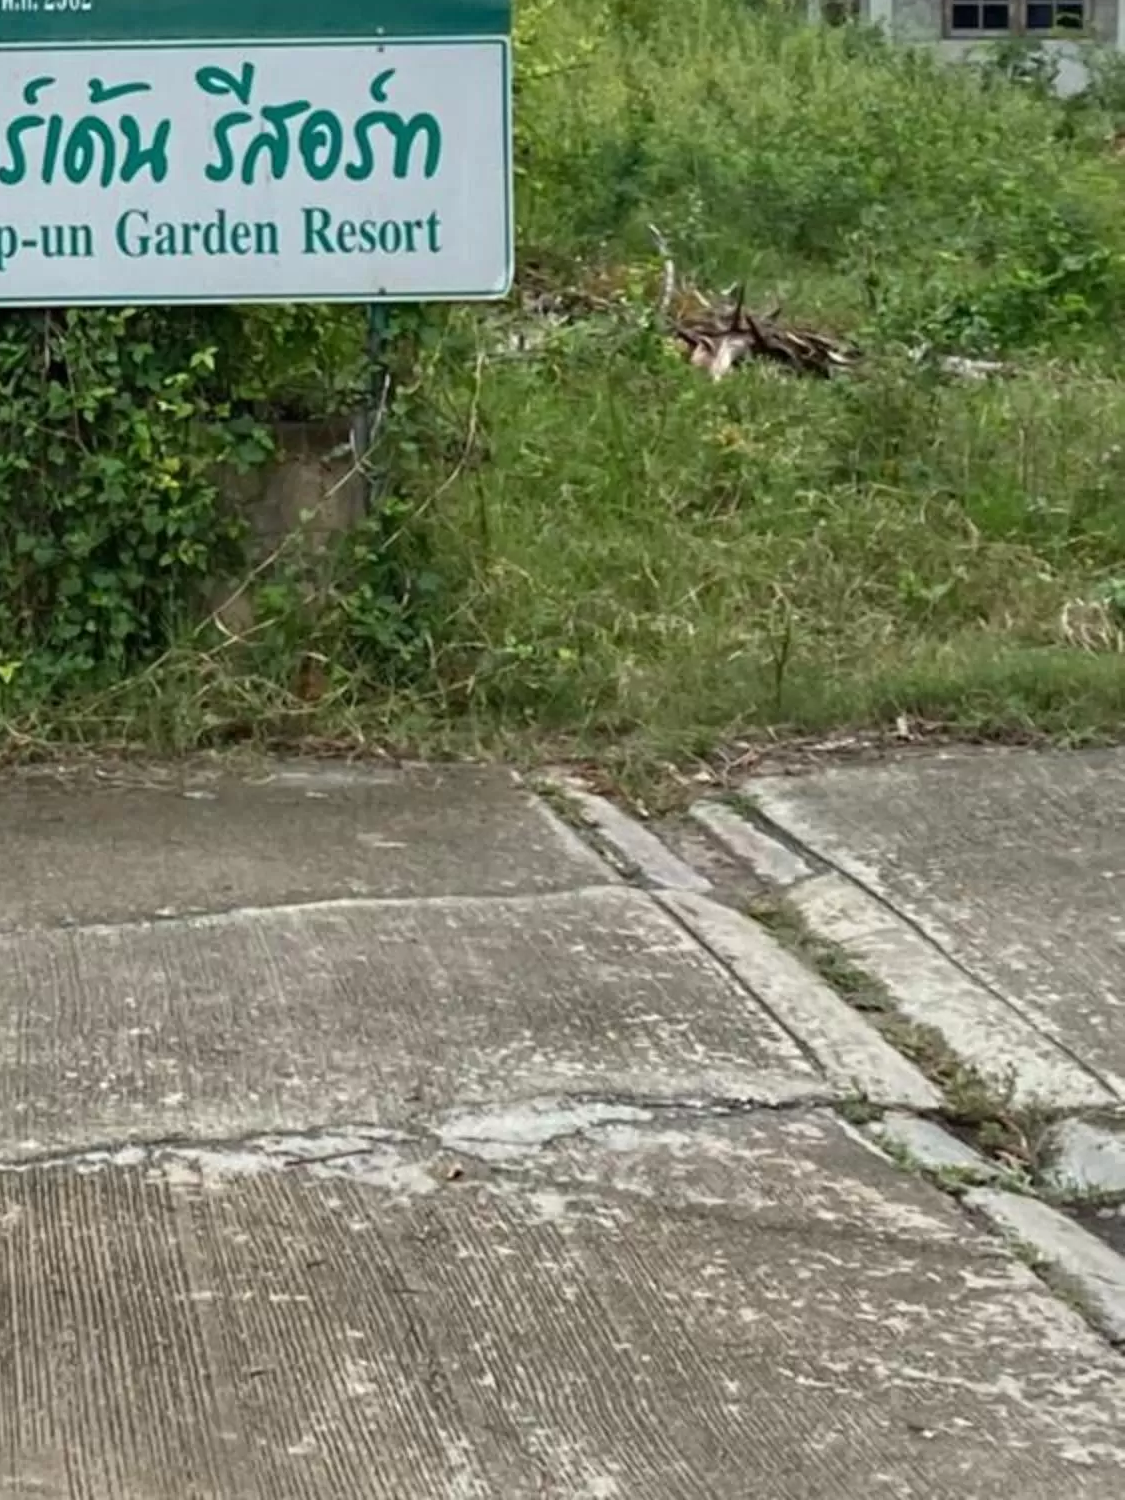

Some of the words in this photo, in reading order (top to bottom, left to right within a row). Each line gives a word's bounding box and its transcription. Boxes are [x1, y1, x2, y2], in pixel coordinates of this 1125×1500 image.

[195, 62, 442, 185] รีสอร์ท
[116, 208, 280, 258] Garden
[302, 206, 442, 255] Resort
